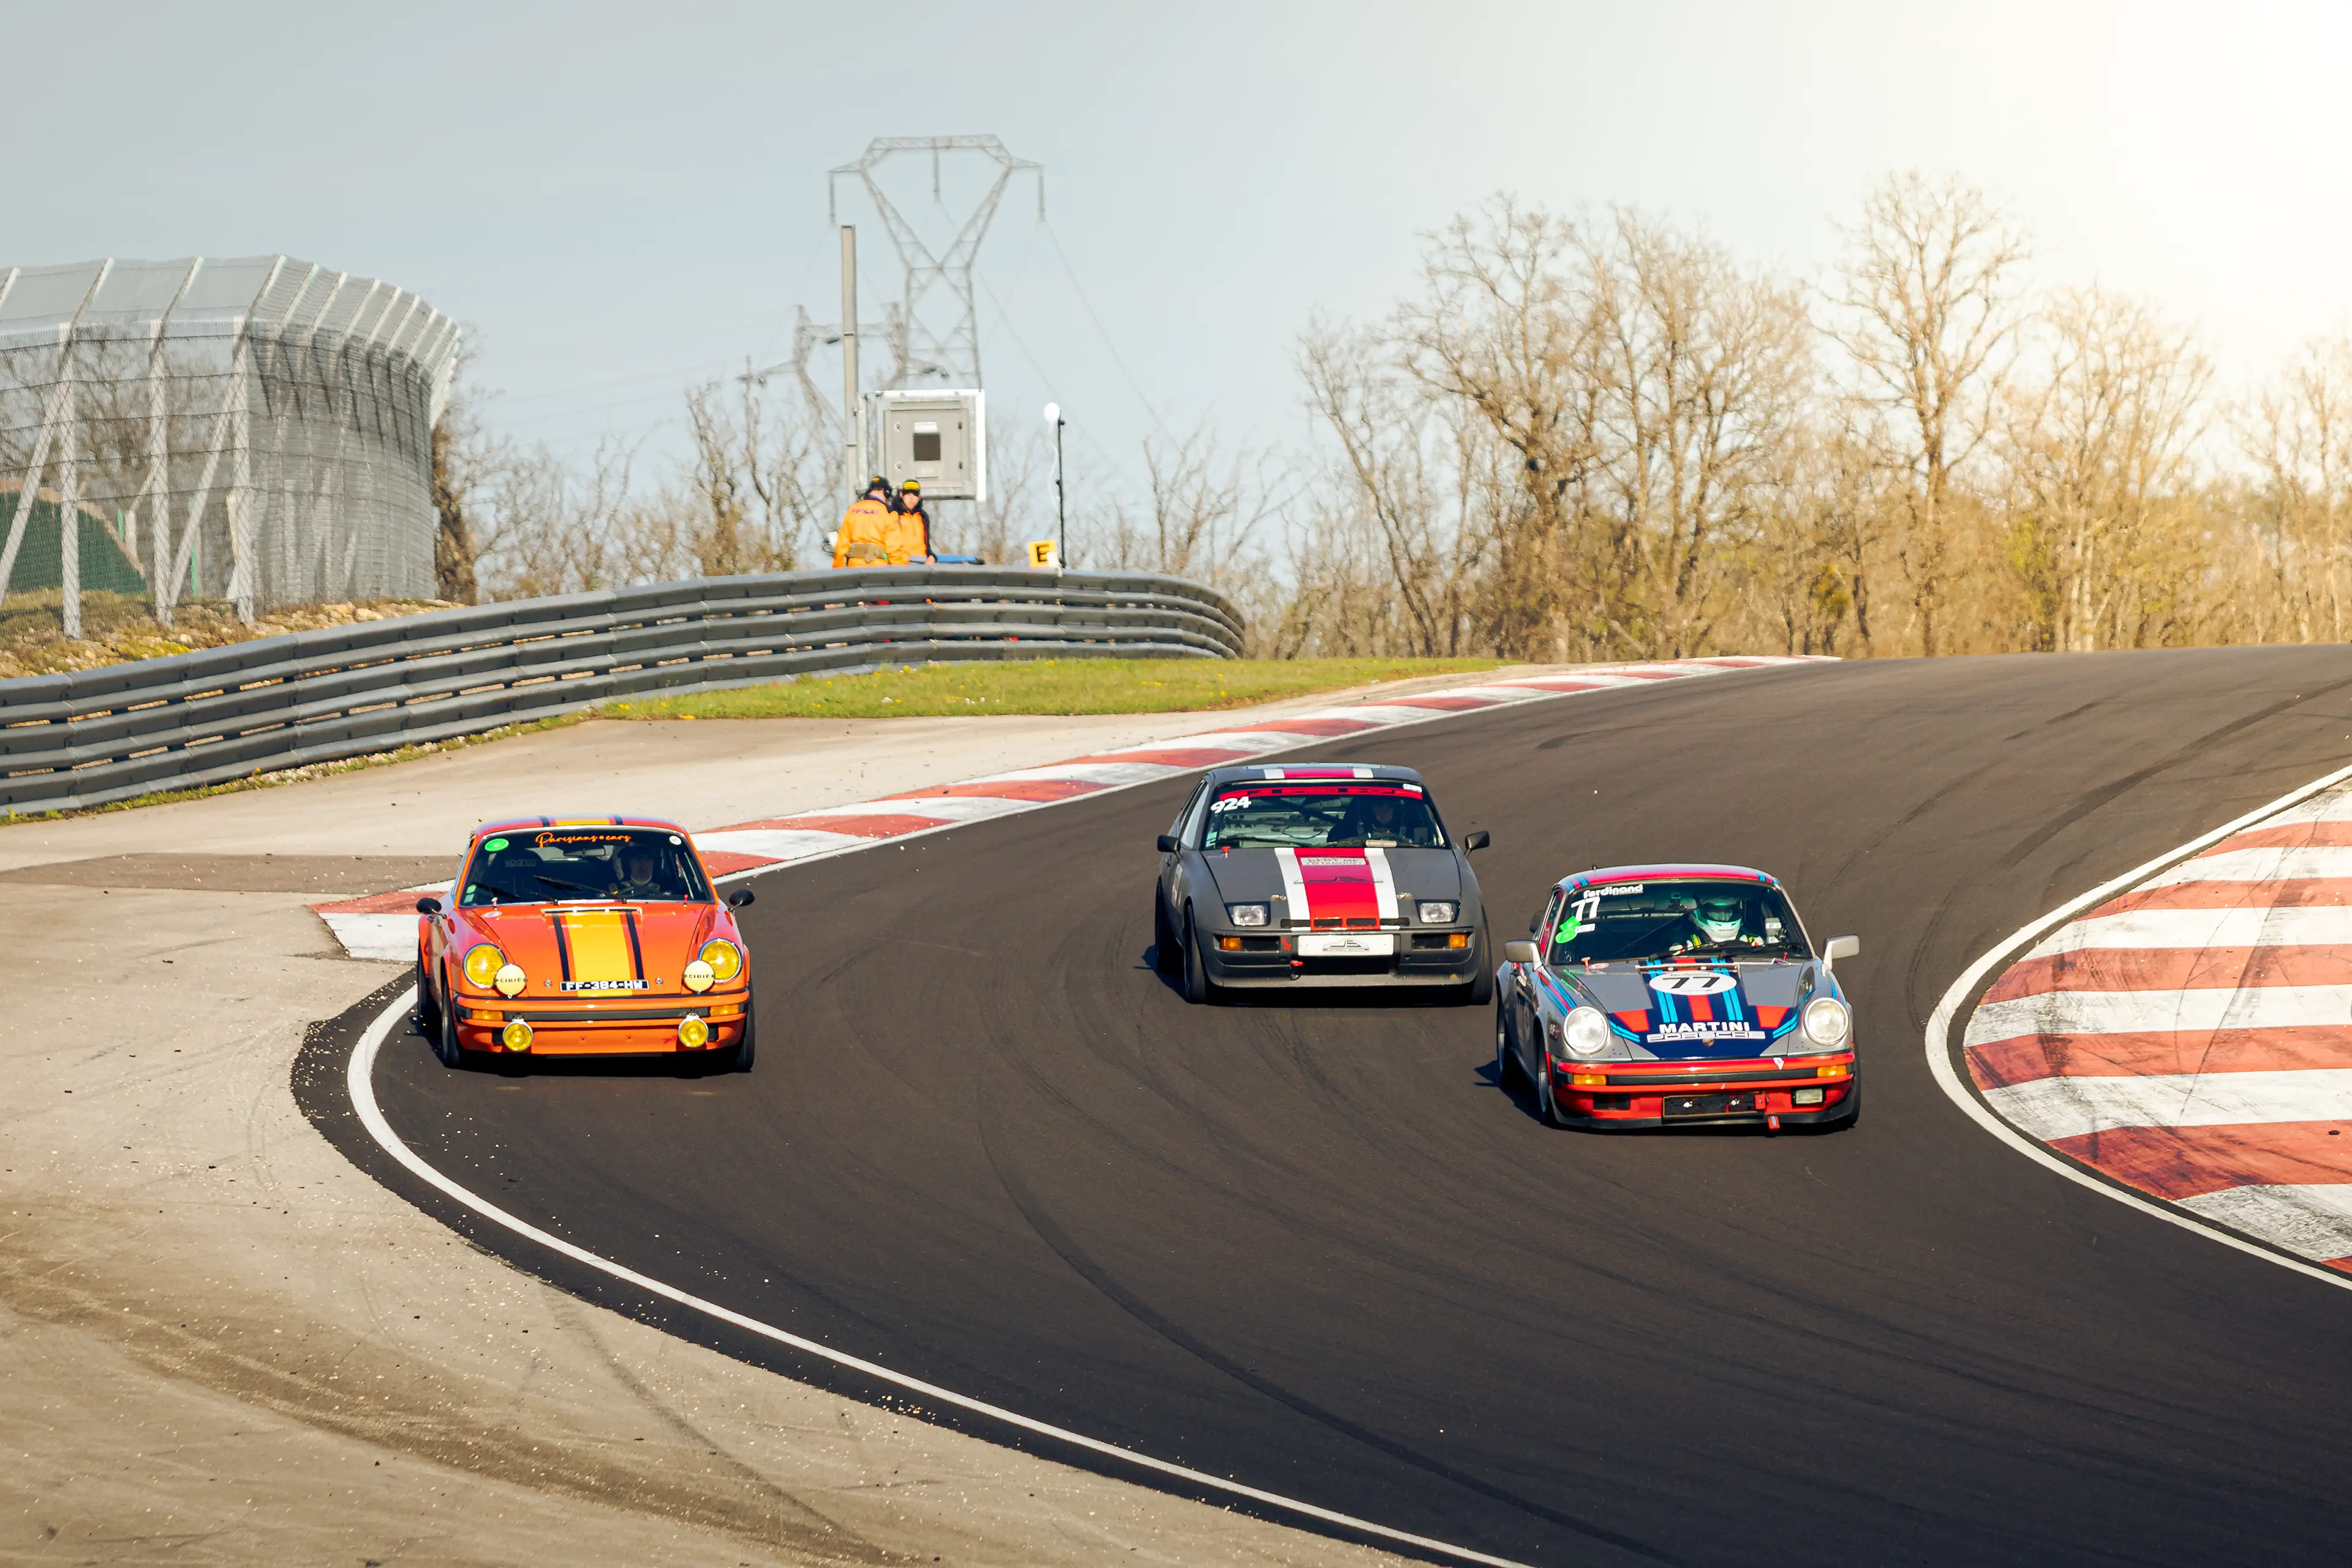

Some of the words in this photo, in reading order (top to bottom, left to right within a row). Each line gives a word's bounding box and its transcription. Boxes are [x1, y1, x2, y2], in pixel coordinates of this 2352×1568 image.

[1035, 544, 1050, 562] E
[1210, 796, 1251, 813] 924
[1583, 884, 1644, 899] ferdinand
[1571, 896, 1600, 922] 77
[566, 980, 643, 991] FF-384-HW
[1662, 976, 1720, 989] 77
[1659, 1021, 1750, 1034] MARTINI
